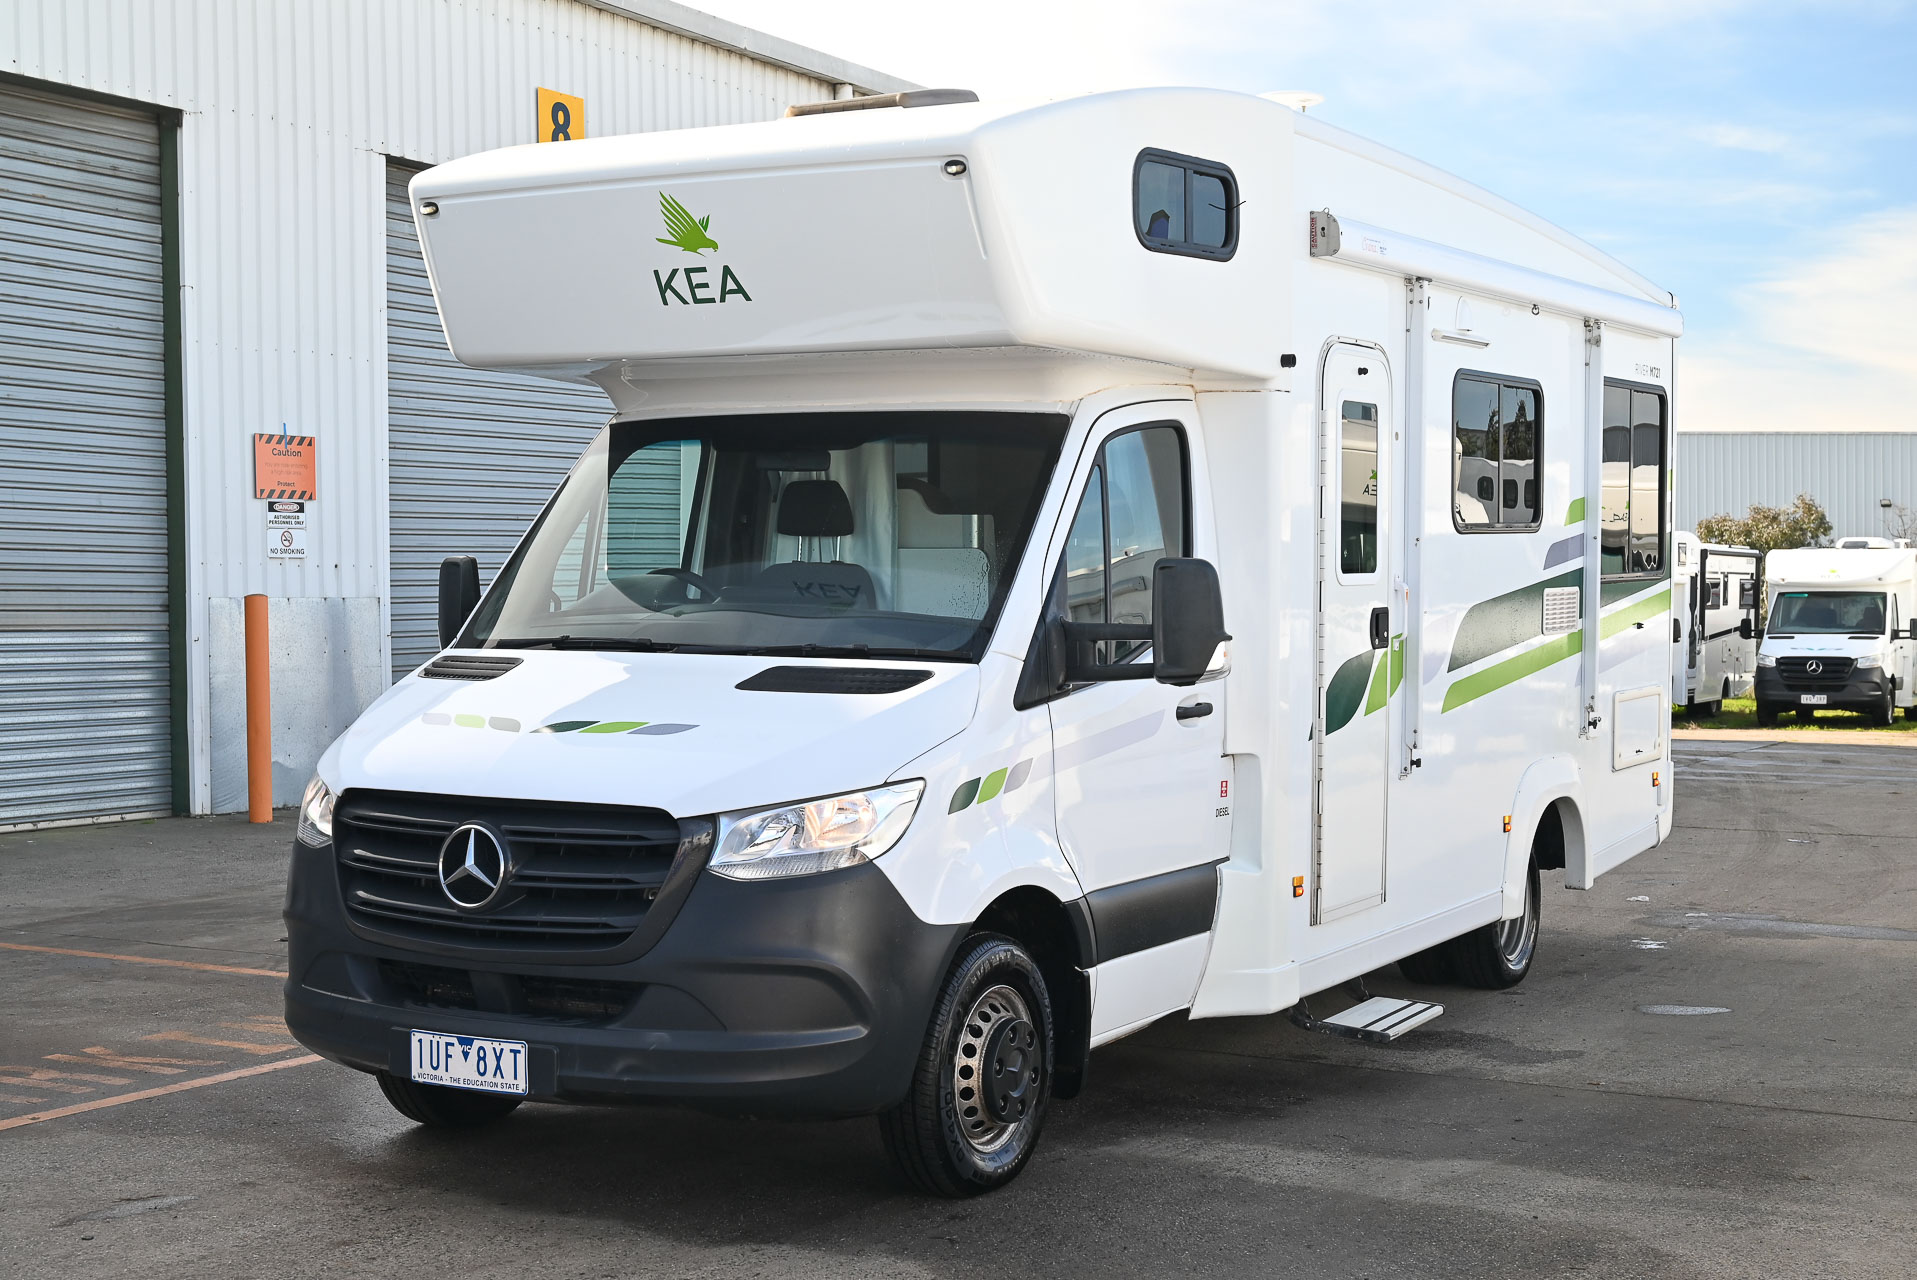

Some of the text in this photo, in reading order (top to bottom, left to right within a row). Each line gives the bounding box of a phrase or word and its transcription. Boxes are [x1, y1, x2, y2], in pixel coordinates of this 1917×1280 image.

[551, 101, 572, 142] 8
[653, 264, 753, 306] KEA
[271, 447, 302, 457] Caution
[275, 503, 298, 511] DANGER
[280, 547, 305, 555] SMOKING
[417, 1038, 522, 1081] 1UF 8XT
[417, 1072, 444, 1082] VICTORIA
[449, 1076, 461, 1085] THE
[462, 1078, 499, 1089] EDUCATION
[500, 1083, 520, 1091] STATE
